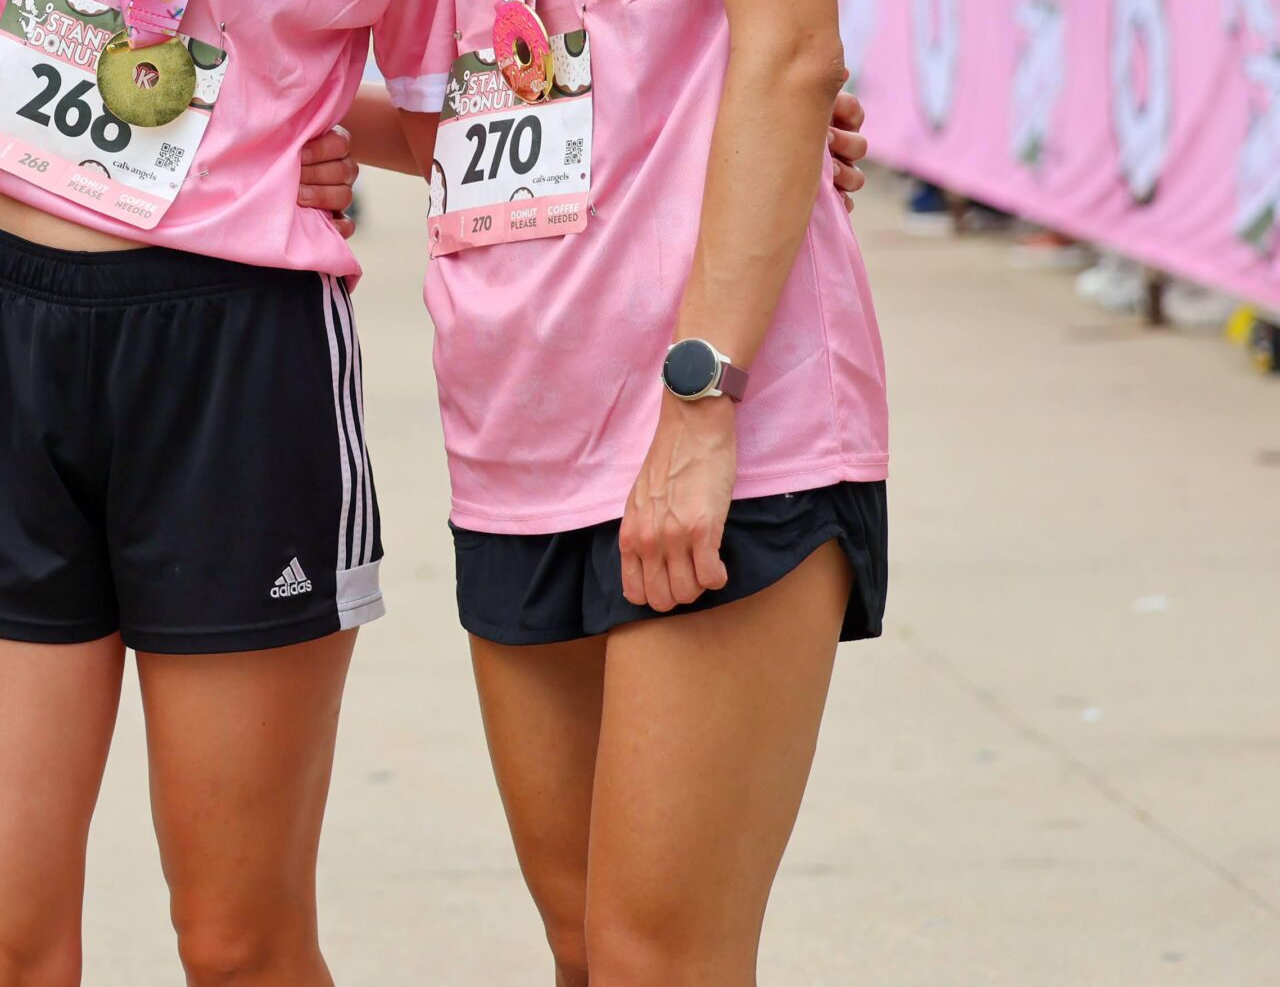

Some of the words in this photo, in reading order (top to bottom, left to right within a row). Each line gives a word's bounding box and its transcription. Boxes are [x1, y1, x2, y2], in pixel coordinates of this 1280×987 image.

[46, 13, 109, 50] STAN'
[16, 63, 131, 152] 268
[461, 114, 542, 185] 270
[17, 152, 50, 173] 268
[546, 172, 570, 184] angels
[67, 180, 104, 201] PLEASE
[114, 201, 153, 219] NEEDED
[547, 203, 580, 215] COFFEE
[472, 215, 492, 233] 270
[510, 218, 537, 231] PLEASE
[548, 213, 579, 225] NEEDED
[270, 579, 313, 599] adidas
